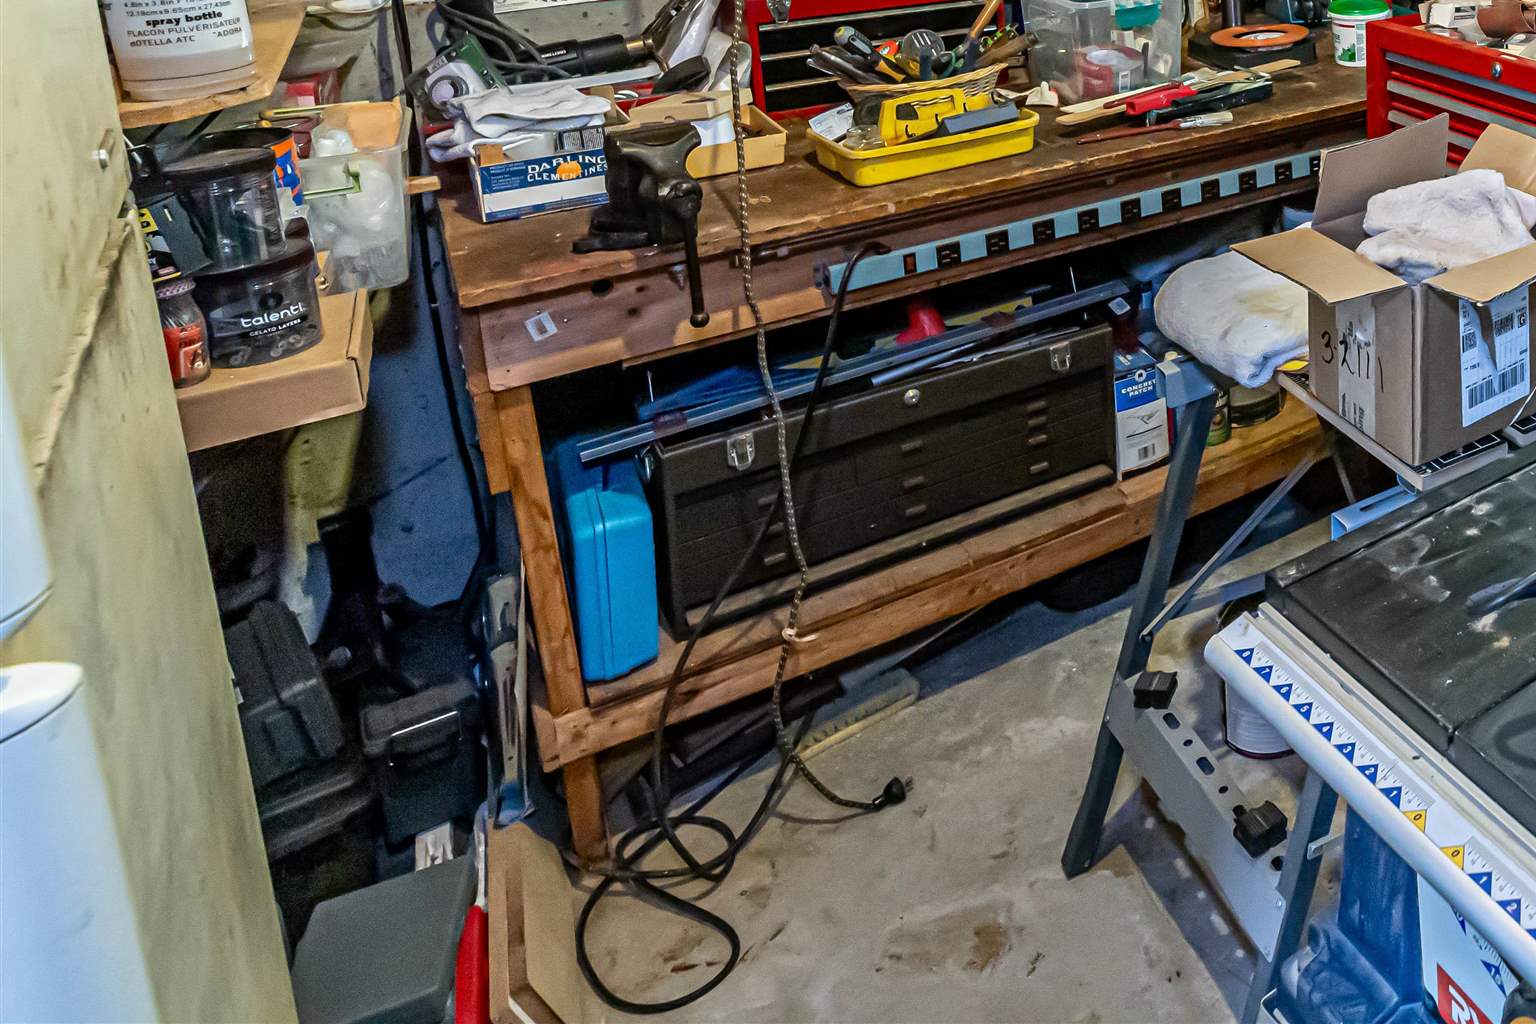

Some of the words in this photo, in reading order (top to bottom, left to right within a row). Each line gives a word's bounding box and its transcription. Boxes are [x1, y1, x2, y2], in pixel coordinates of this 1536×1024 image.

[146, 16, 181, 29] spray
[185, 10, 223, 23] bottle
[240, 302, 304, 328] talenti
[249, 325, 277, 337] GELATO
[278, 318, 301, 331] LAYERS
[1129, 385, 1153, 398] PATCH
[1260, 667, 1270, 675] 7
[1280, 685, 1288, 694] 6
[1300, 704, 1308, 713] 5
[1321, 725, 1330, 733] 4
[1342, 745, 1351, 754] 3
[1364, 767, 1375, 776] 2
[1390, 790, 1398, 798] 1
[1413, 813, 1422, 822] 0
[1450, 849, 1460, 858] 0
[1479, 876, 1488, 884] 1
[1506, 902, 1518, 912] 2
